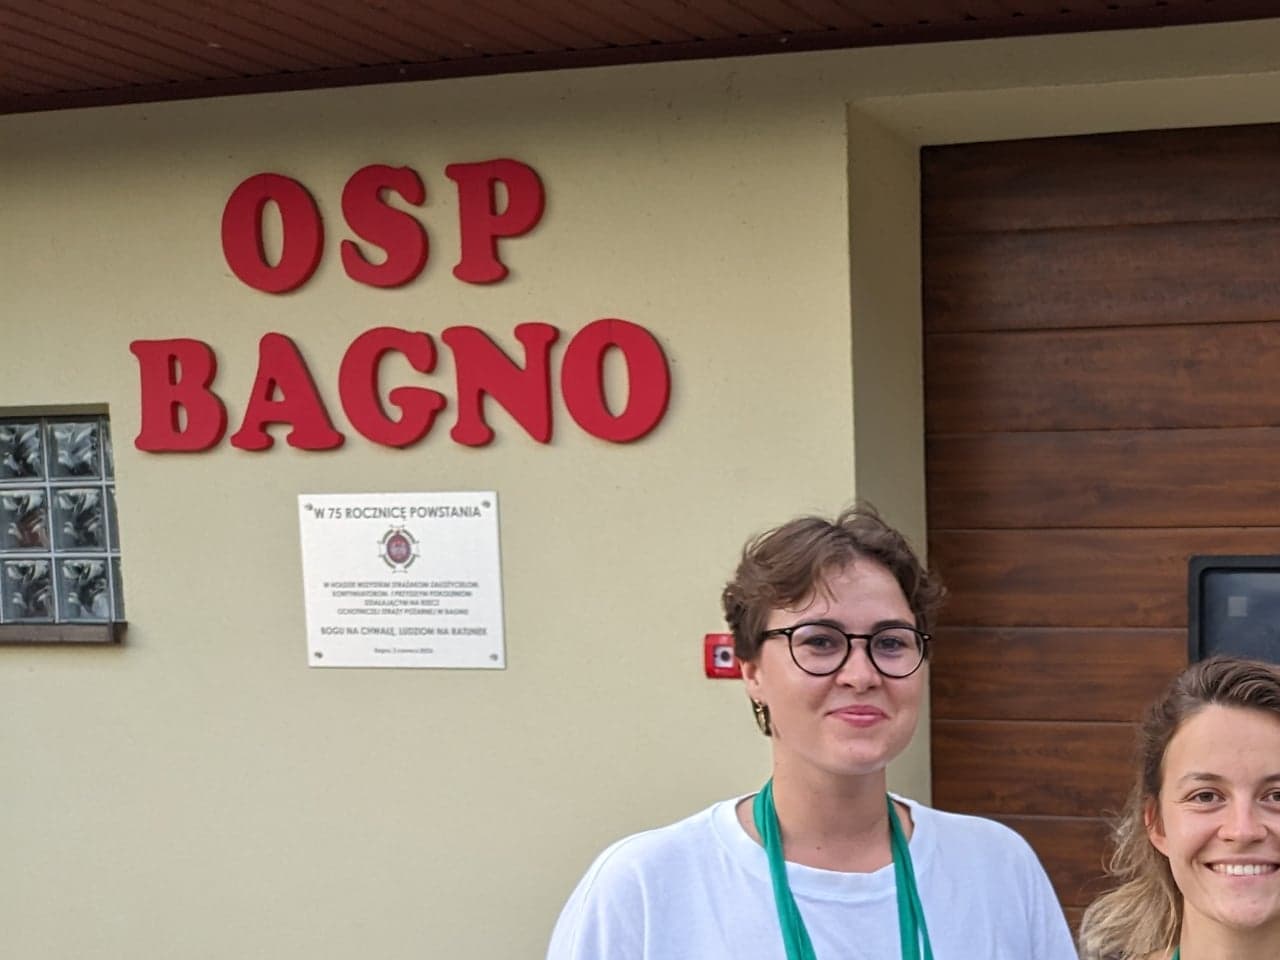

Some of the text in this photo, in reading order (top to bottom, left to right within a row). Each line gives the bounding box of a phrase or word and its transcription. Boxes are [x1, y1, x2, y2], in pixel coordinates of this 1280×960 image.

[222, 159, 545, 294] OSP
[130, 319, 671, 453] BAGNO
[314, 505, 482, 521] W 75 ROCZNICĘ POWSTANIA
